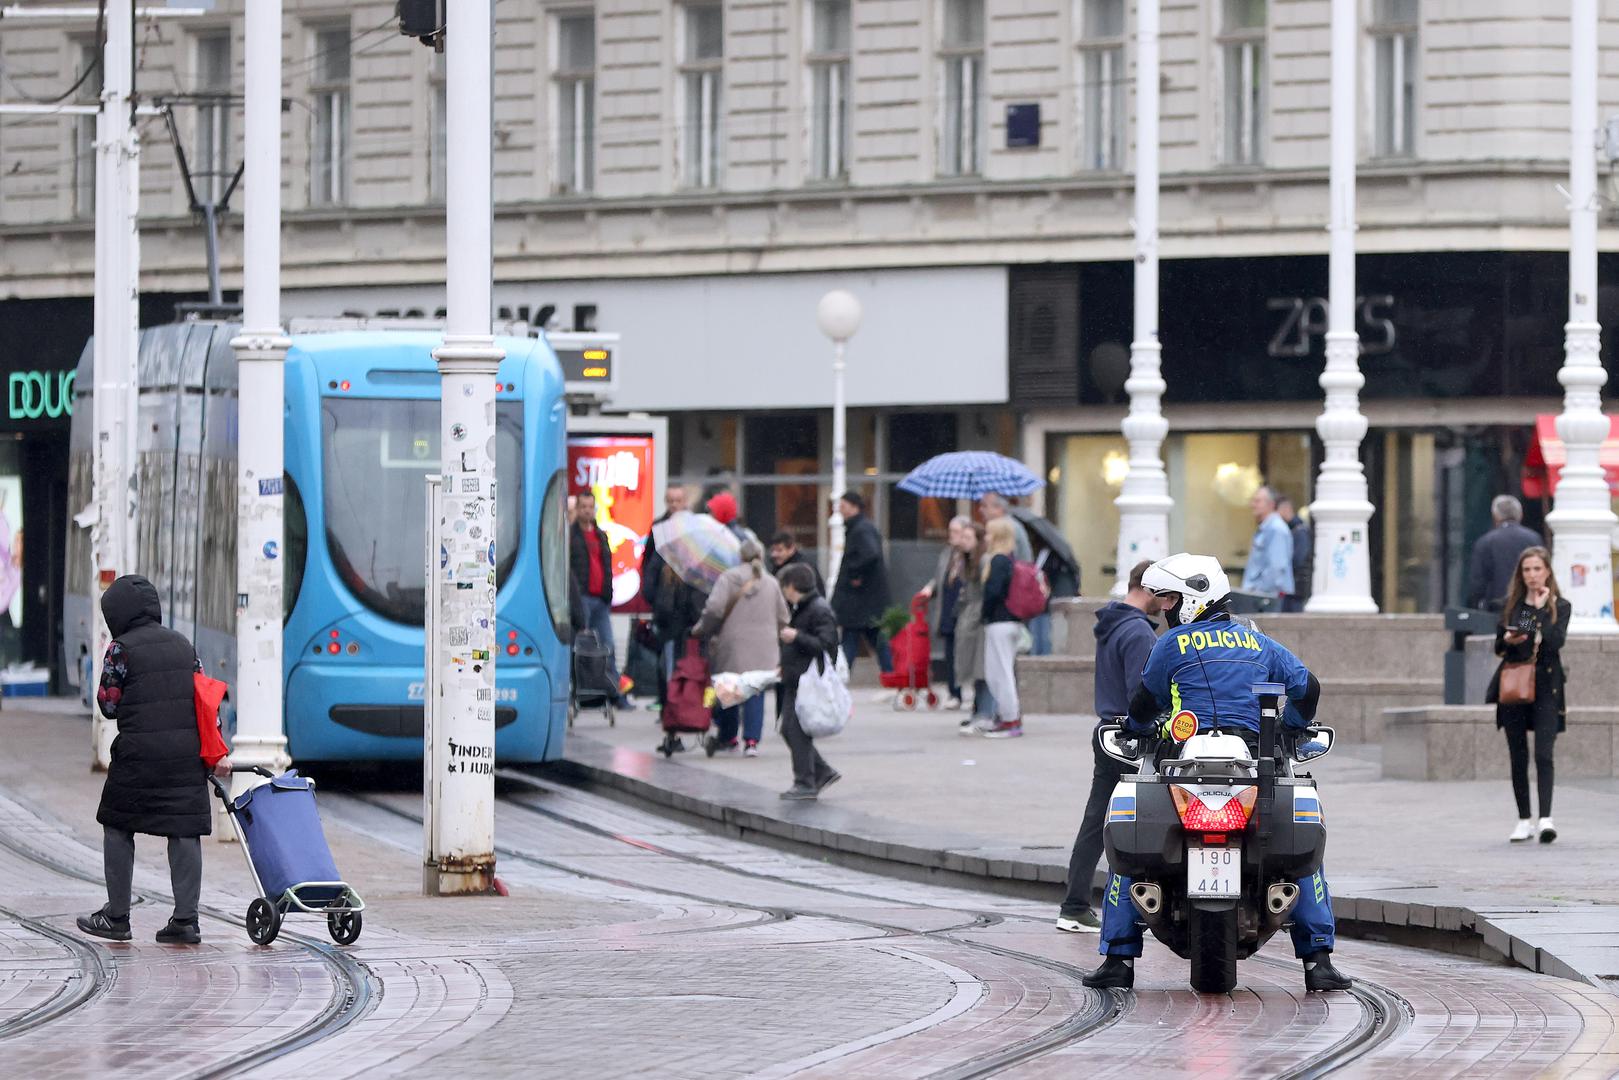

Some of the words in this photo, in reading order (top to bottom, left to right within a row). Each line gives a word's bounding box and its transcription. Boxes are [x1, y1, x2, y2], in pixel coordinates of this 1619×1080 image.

[1177, 630, 1262, 655] POLICIJA
[1176, 719, 1194, 728] STOP
[448, 743, 493, 759] TINDER
[1200, 851, 1231, 865] 190
[1198, 879, 1229, 892] 441
